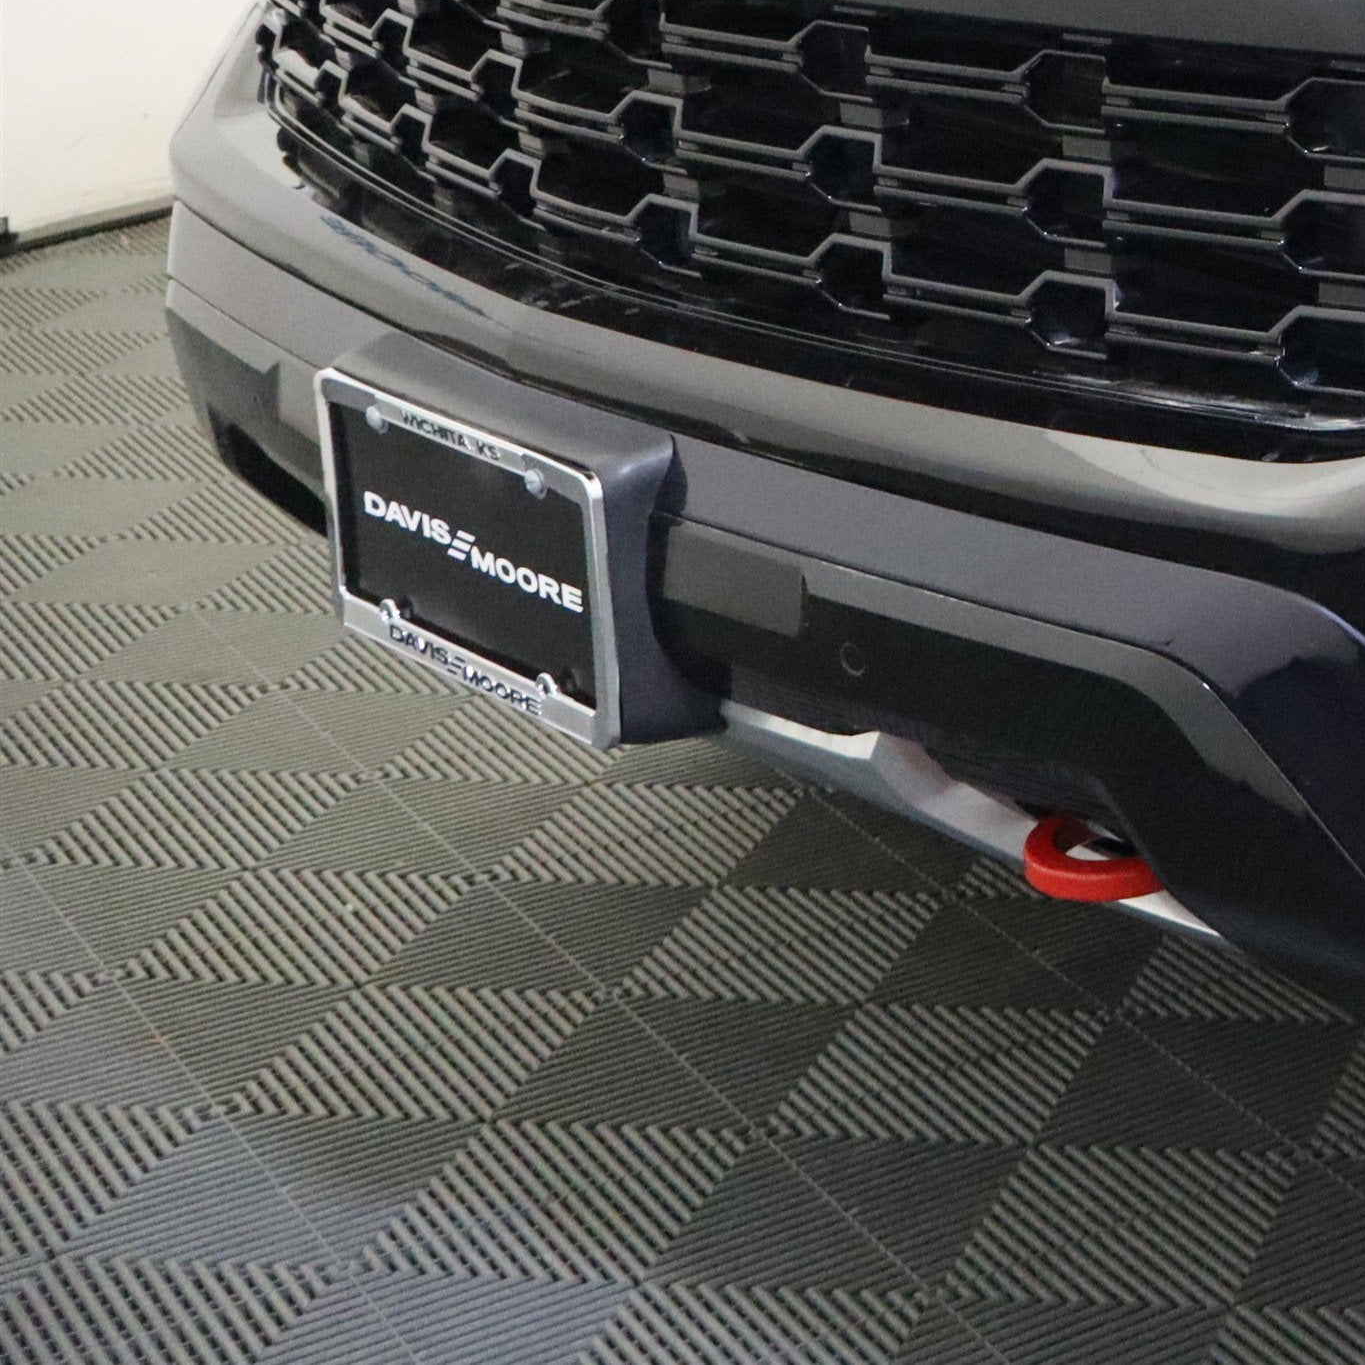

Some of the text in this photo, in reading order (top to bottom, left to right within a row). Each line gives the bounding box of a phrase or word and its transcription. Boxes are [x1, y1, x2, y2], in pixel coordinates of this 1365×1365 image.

[476, 439, 501, 461] KS
[363, 490, 584, 614] DAVIS MOORE
[389, 623, 542, 716] DAVIS MOORE
